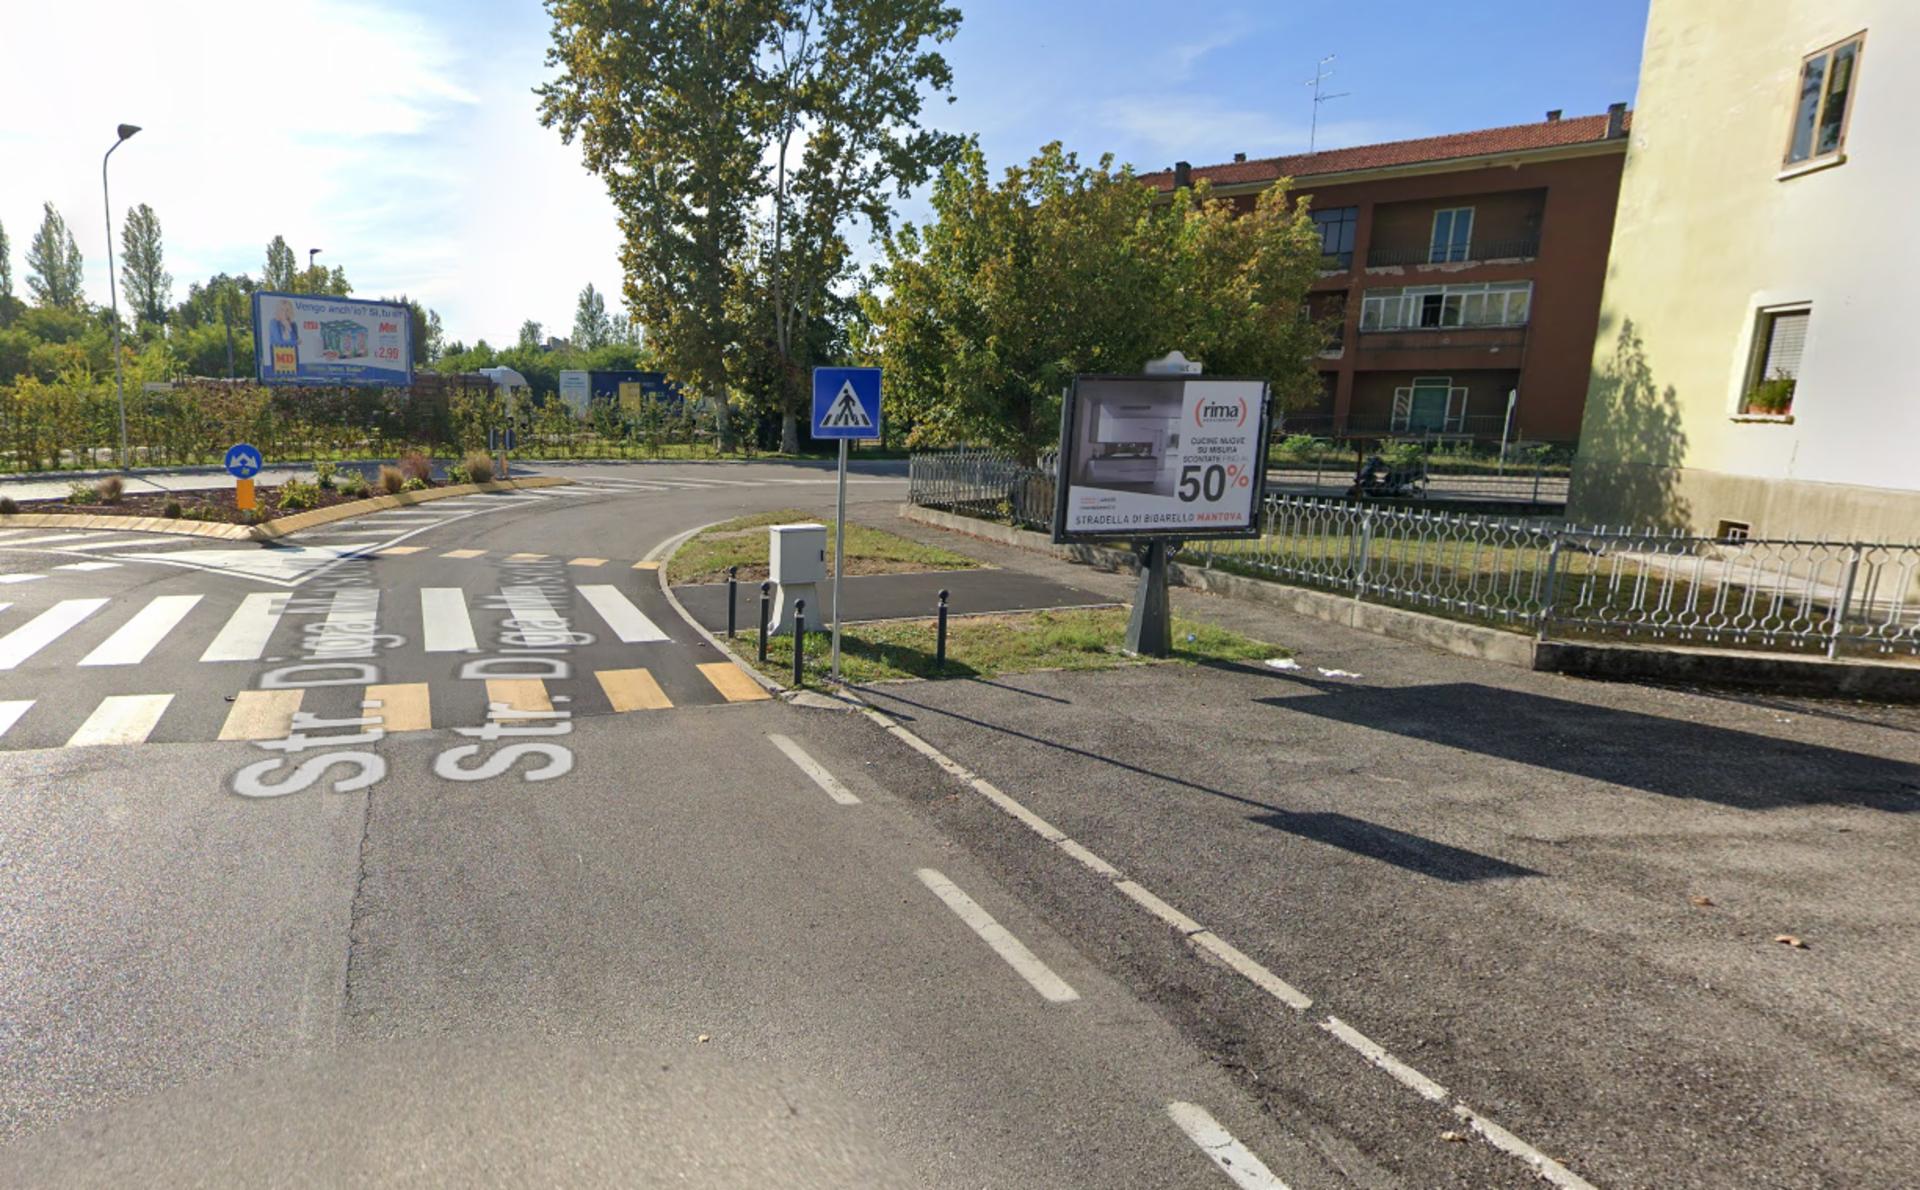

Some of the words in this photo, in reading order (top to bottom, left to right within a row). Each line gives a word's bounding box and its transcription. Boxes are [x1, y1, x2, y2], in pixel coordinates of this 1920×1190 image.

[295, 301, 325, 314] Vengo
[1190, 437, 1218, 445] CUCINE
[1220, 437, 1246, 445] NUOVE
[1197, 446, 1207, 454] SU
[1209, 446, 1237, 454] MISURA
[1183, 455, 1220, 463] SCONTATE
[1178, 464, 1249, 503] 50%
[1075, 513, 1129, 525] STRADELLA
[1132, 513, 1142, 523] DI
[1143, 512, 1194, 524] BIGARELLO
[1195, 511, 1242, 522] MANTOVA
